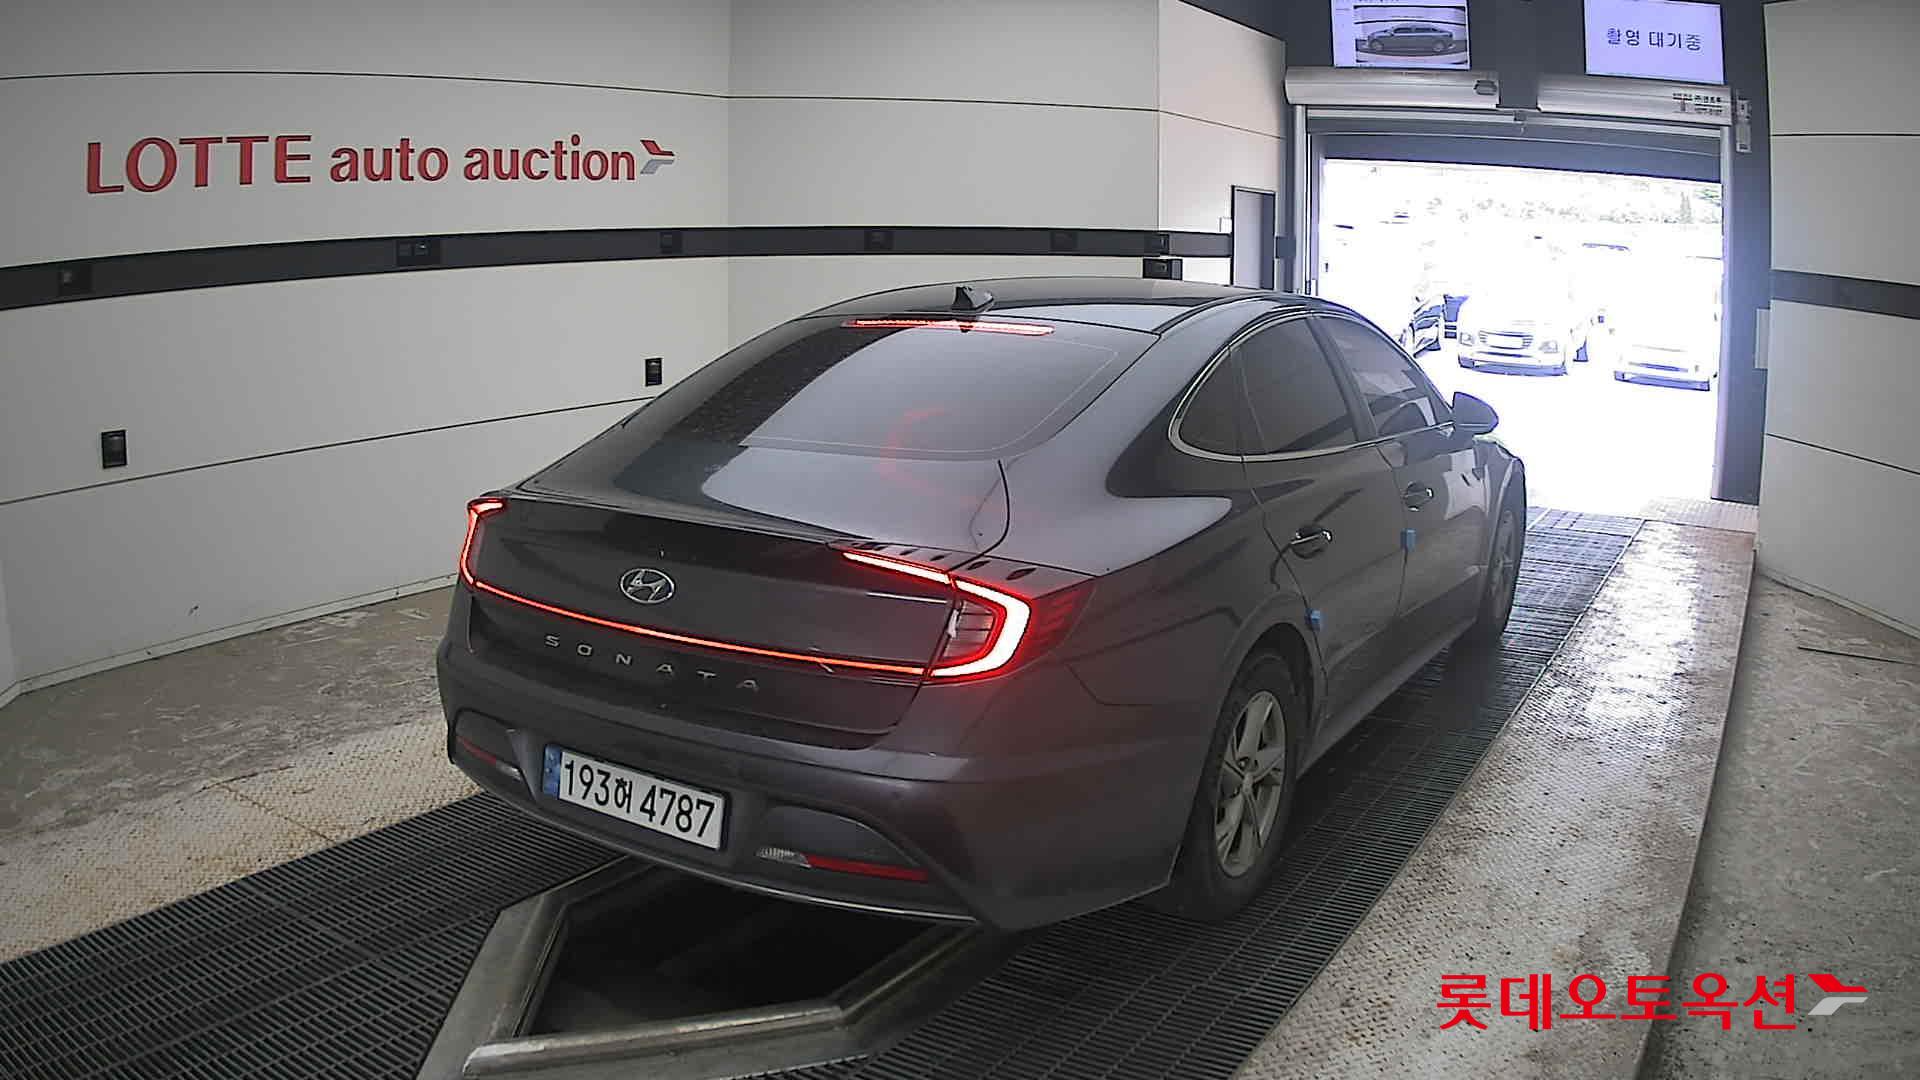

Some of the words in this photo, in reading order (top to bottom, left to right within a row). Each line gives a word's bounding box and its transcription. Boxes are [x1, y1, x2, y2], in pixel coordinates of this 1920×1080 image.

[1648, 31, 1701, 51] 대기중
[86, 134, 312, 194] LOTTE
[329, 137, 449, 182] auto
[463, 133, 636, 182] auction
[544, 634, 759, 692] SONATA
[564, 759, 633, 814] 193허
[639, 784, 715, 838] 4787
